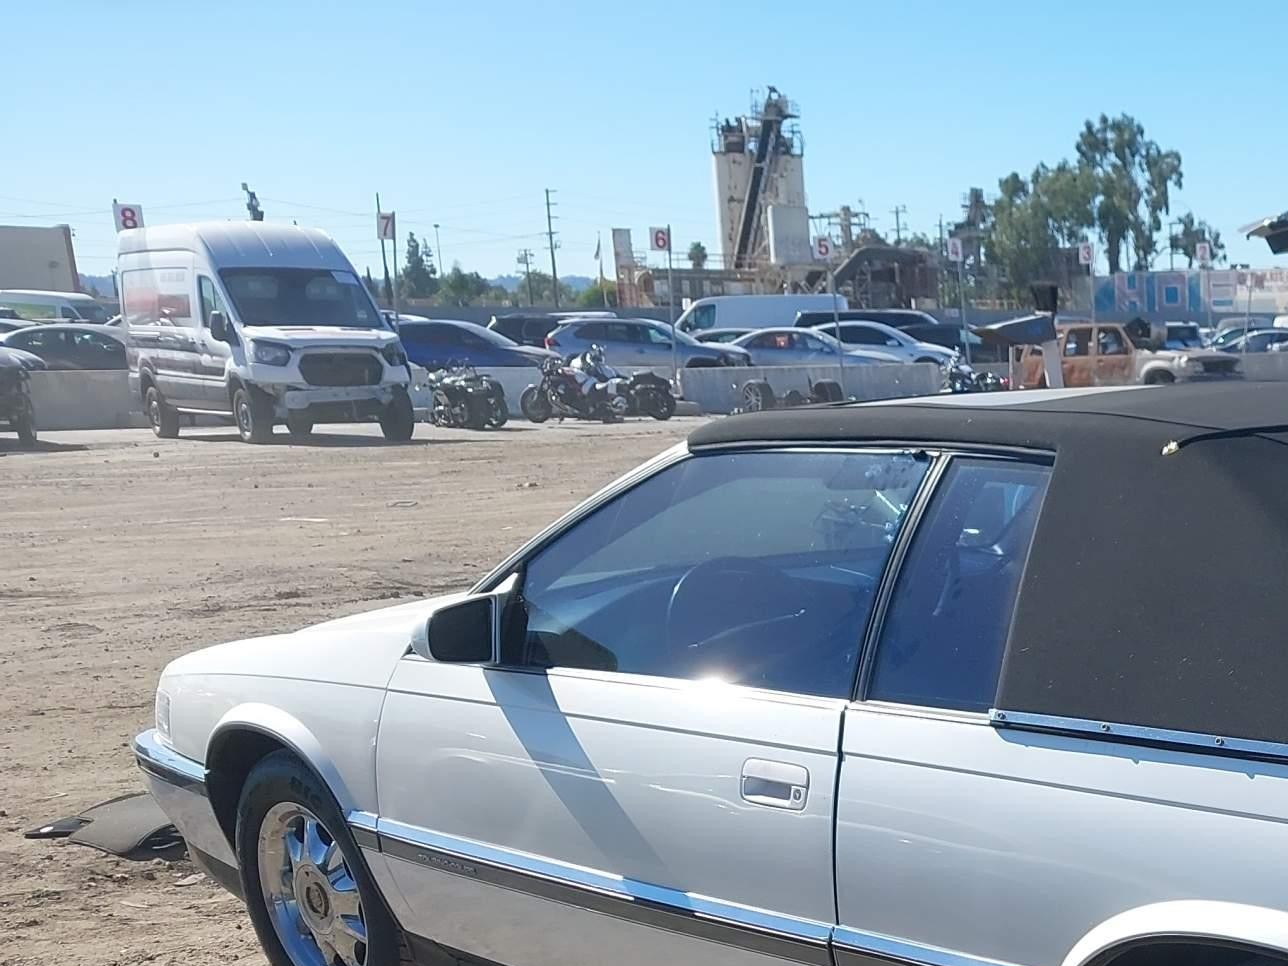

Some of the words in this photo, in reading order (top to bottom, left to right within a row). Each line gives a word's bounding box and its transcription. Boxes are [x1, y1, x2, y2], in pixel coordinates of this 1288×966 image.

[120, 207, 138, 230] 8
[380, 215, 392, 237] 7
[655, 229, 667, 249] 6
[817, 238, 830, 256] 5
